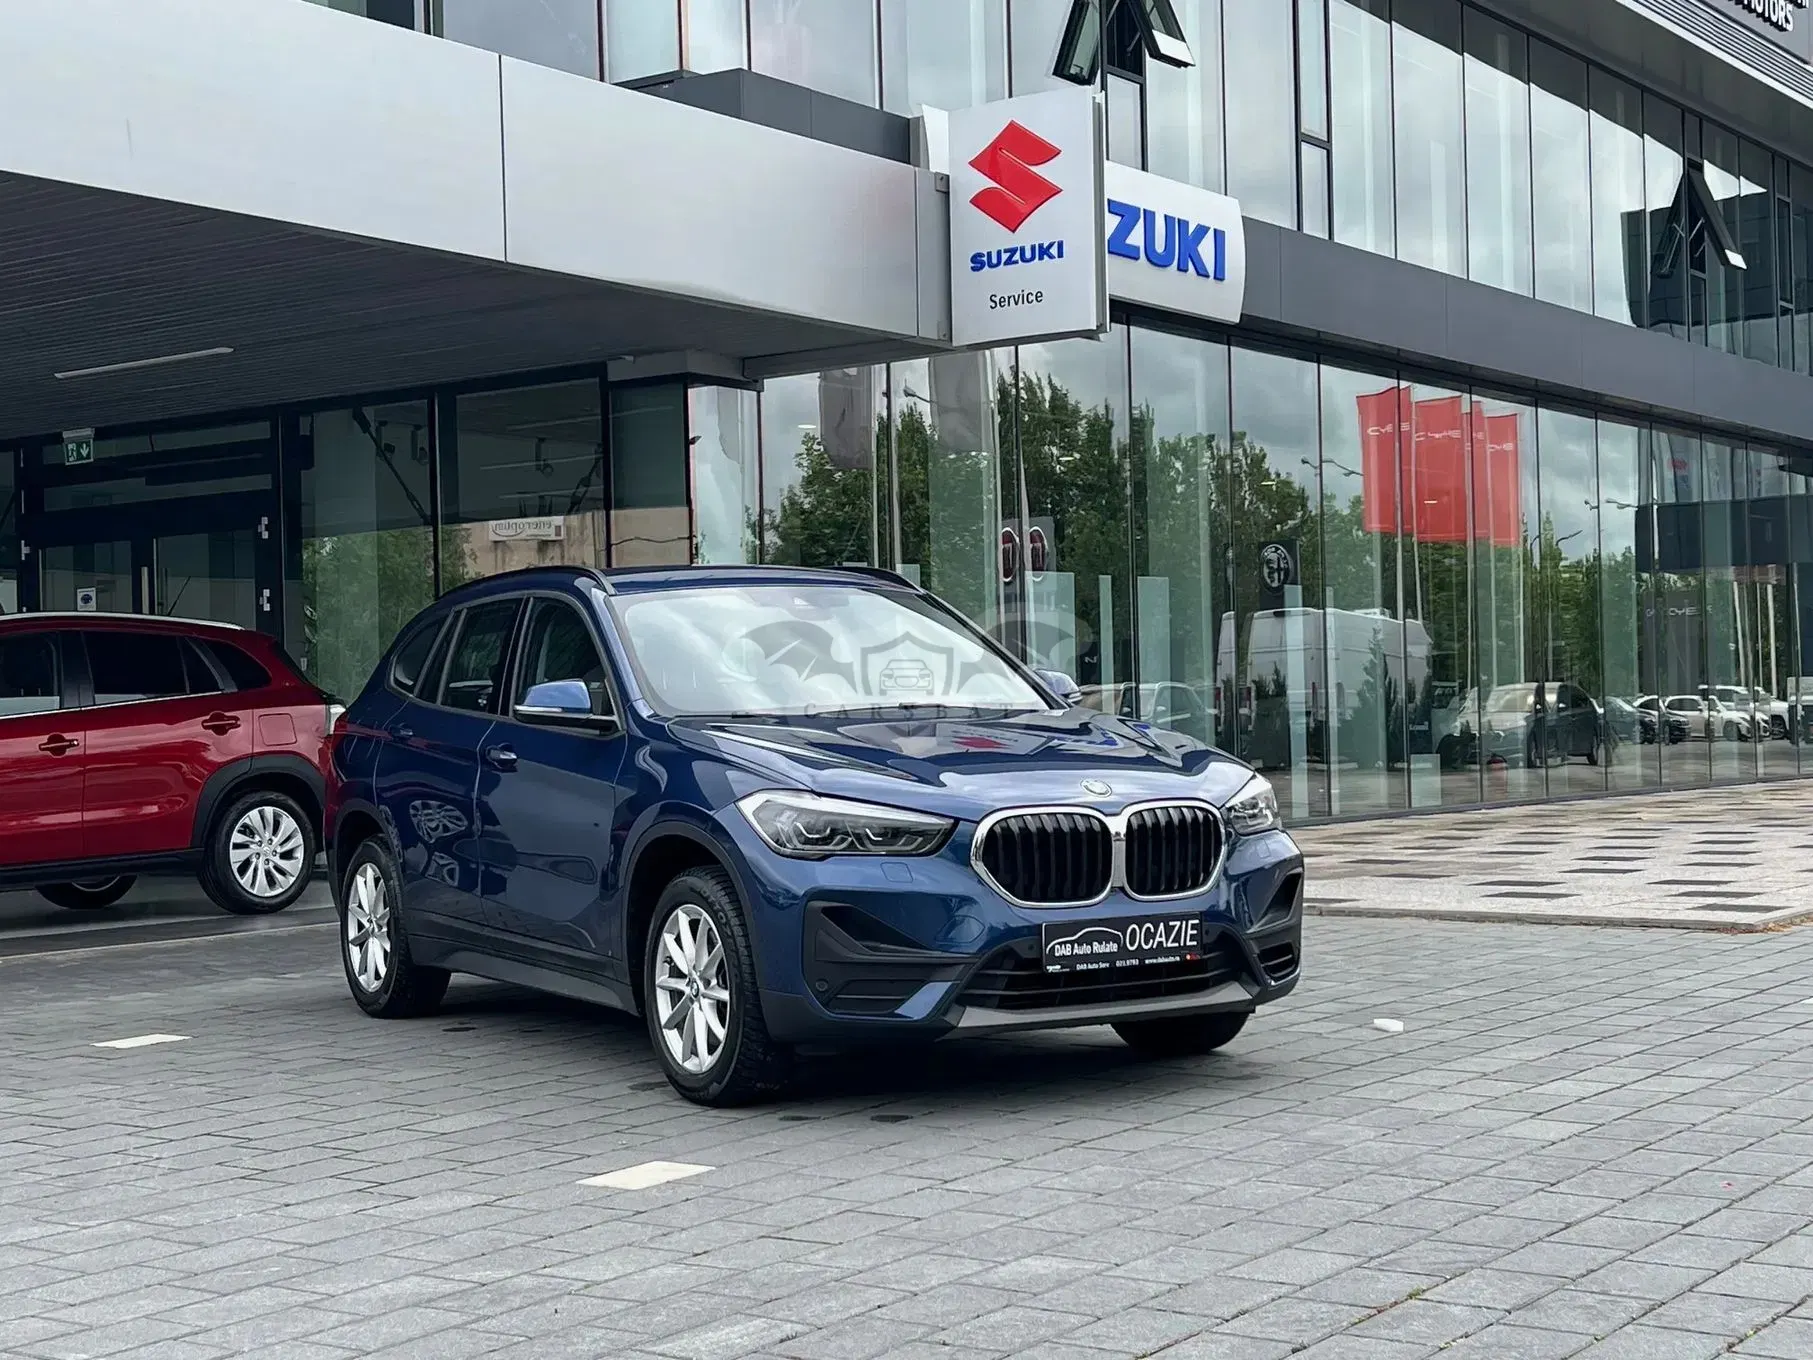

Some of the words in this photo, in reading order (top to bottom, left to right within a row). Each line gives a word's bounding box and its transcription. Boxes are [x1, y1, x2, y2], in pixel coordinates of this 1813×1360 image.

[1743, 0, 1794, 32] OTORS
[970, 239, 1064, 272] SUZUKI
[989, 289, 1044, 310] Service
[1054, 943, 1071, 957] DAB
[1073, 942, 1092, 956] Auto
[1092, 941, 1118, 954] Rulate
[1126, 919, 1200, 951] OCAZIE
